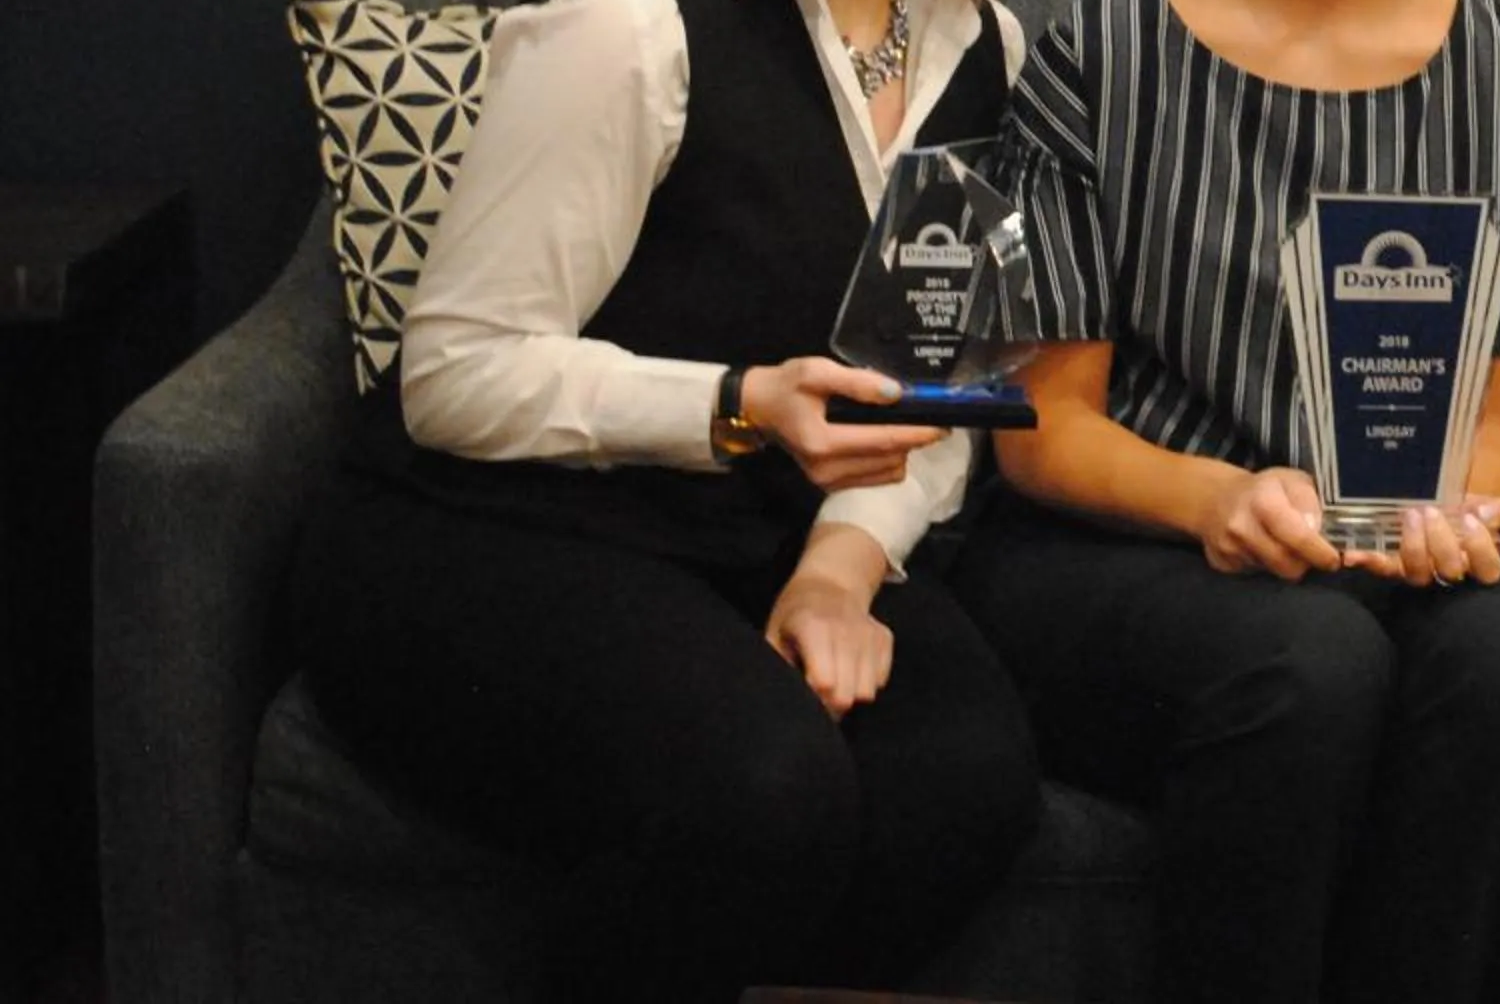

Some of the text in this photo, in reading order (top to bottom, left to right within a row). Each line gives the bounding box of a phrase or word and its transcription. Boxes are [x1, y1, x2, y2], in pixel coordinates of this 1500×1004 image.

[1343, 271, 1446, 289] Days Inn
[906, 290, 967, 303] PROPERTY
[916, 302, 957, 315] OF THE
[920, 315, 952, 328] YEAR
[1378, 335, 1410, 348] 2018
[1341, 357, 1446, 374] CHAIRMAN'S
[1362, 376, 1424, 393] AWARD
[1365, 424, 1417, 438] LINDSAY
